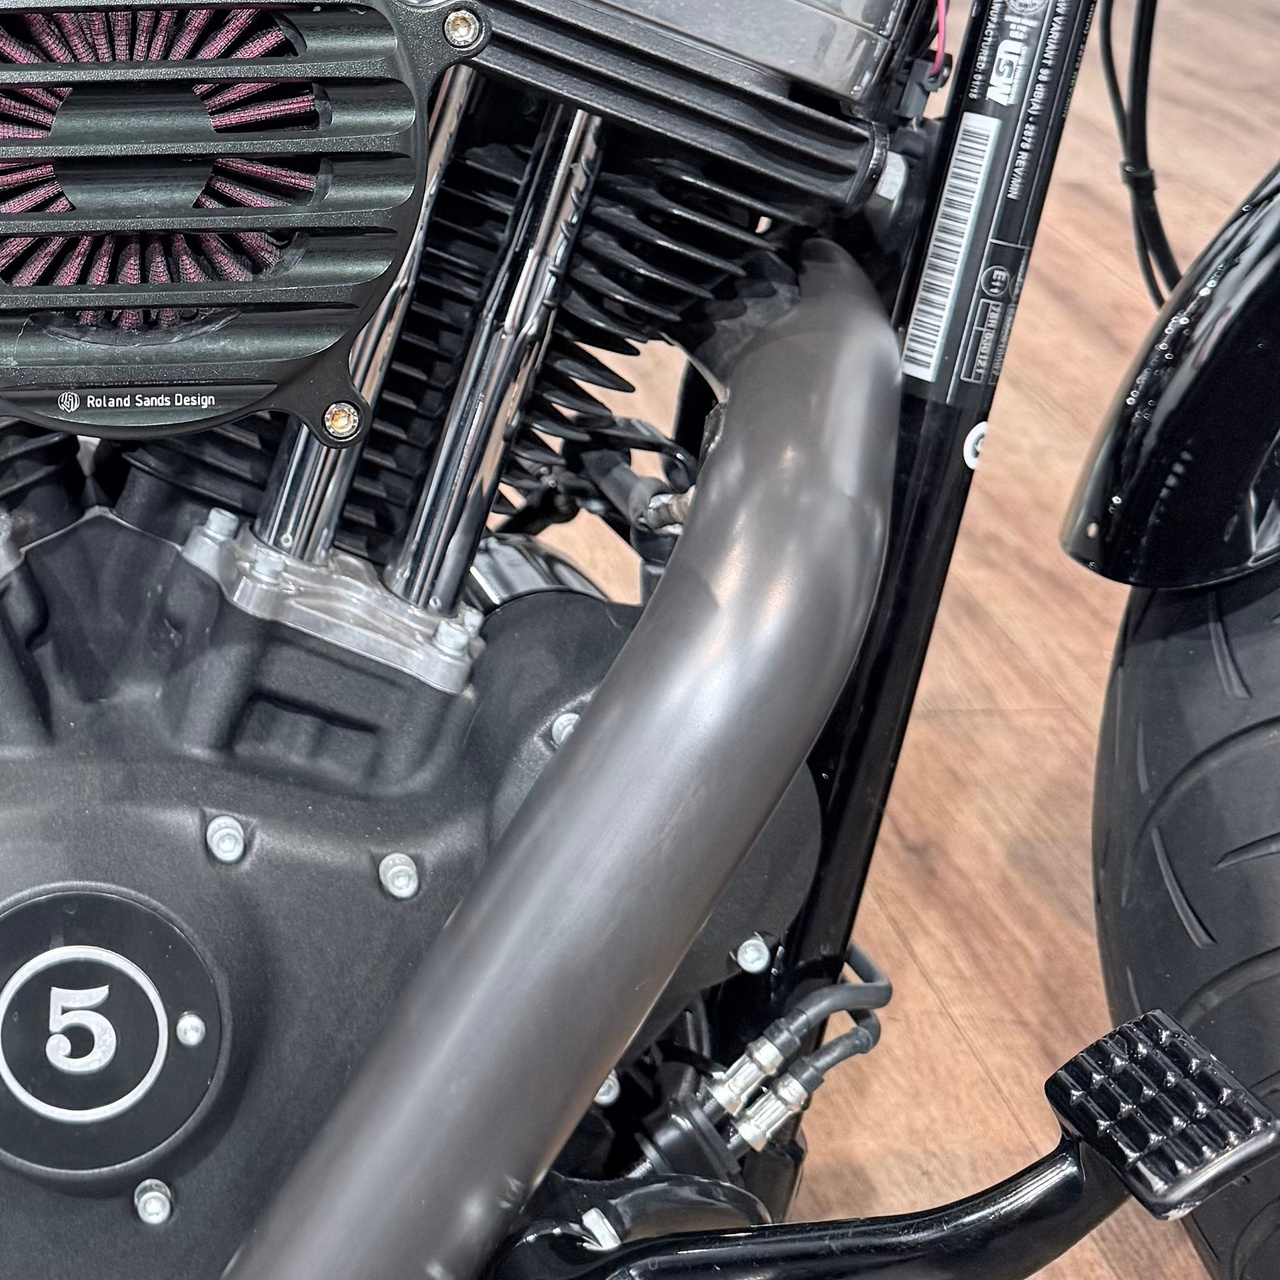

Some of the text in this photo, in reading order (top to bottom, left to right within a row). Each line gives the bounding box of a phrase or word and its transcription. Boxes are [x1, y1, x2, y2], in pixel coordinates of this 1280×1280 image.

[1040, 14, 1064, 66] VARIANT
[87, 393, 216, 408] Roland Sands Design
[45, 984, 117, 1075] 5
